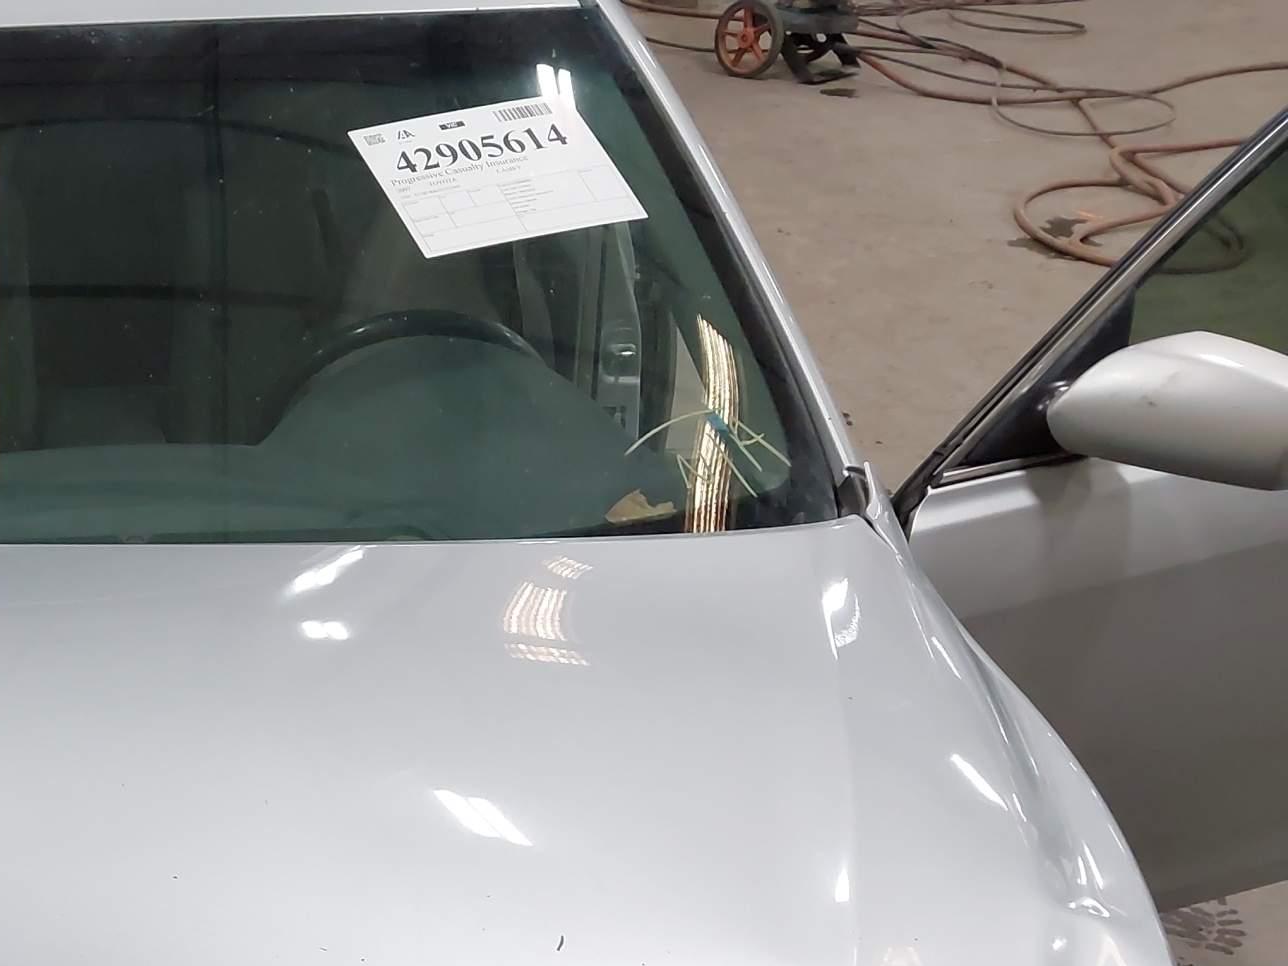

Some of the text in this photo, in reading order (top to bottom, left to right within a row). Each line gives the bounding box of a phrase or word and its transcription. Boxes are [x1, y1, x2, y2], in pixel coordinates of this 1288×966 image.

[396, 123, 568, 173] 42905614
[390, 155, 529, 187] Progressive Casualty Insurance
